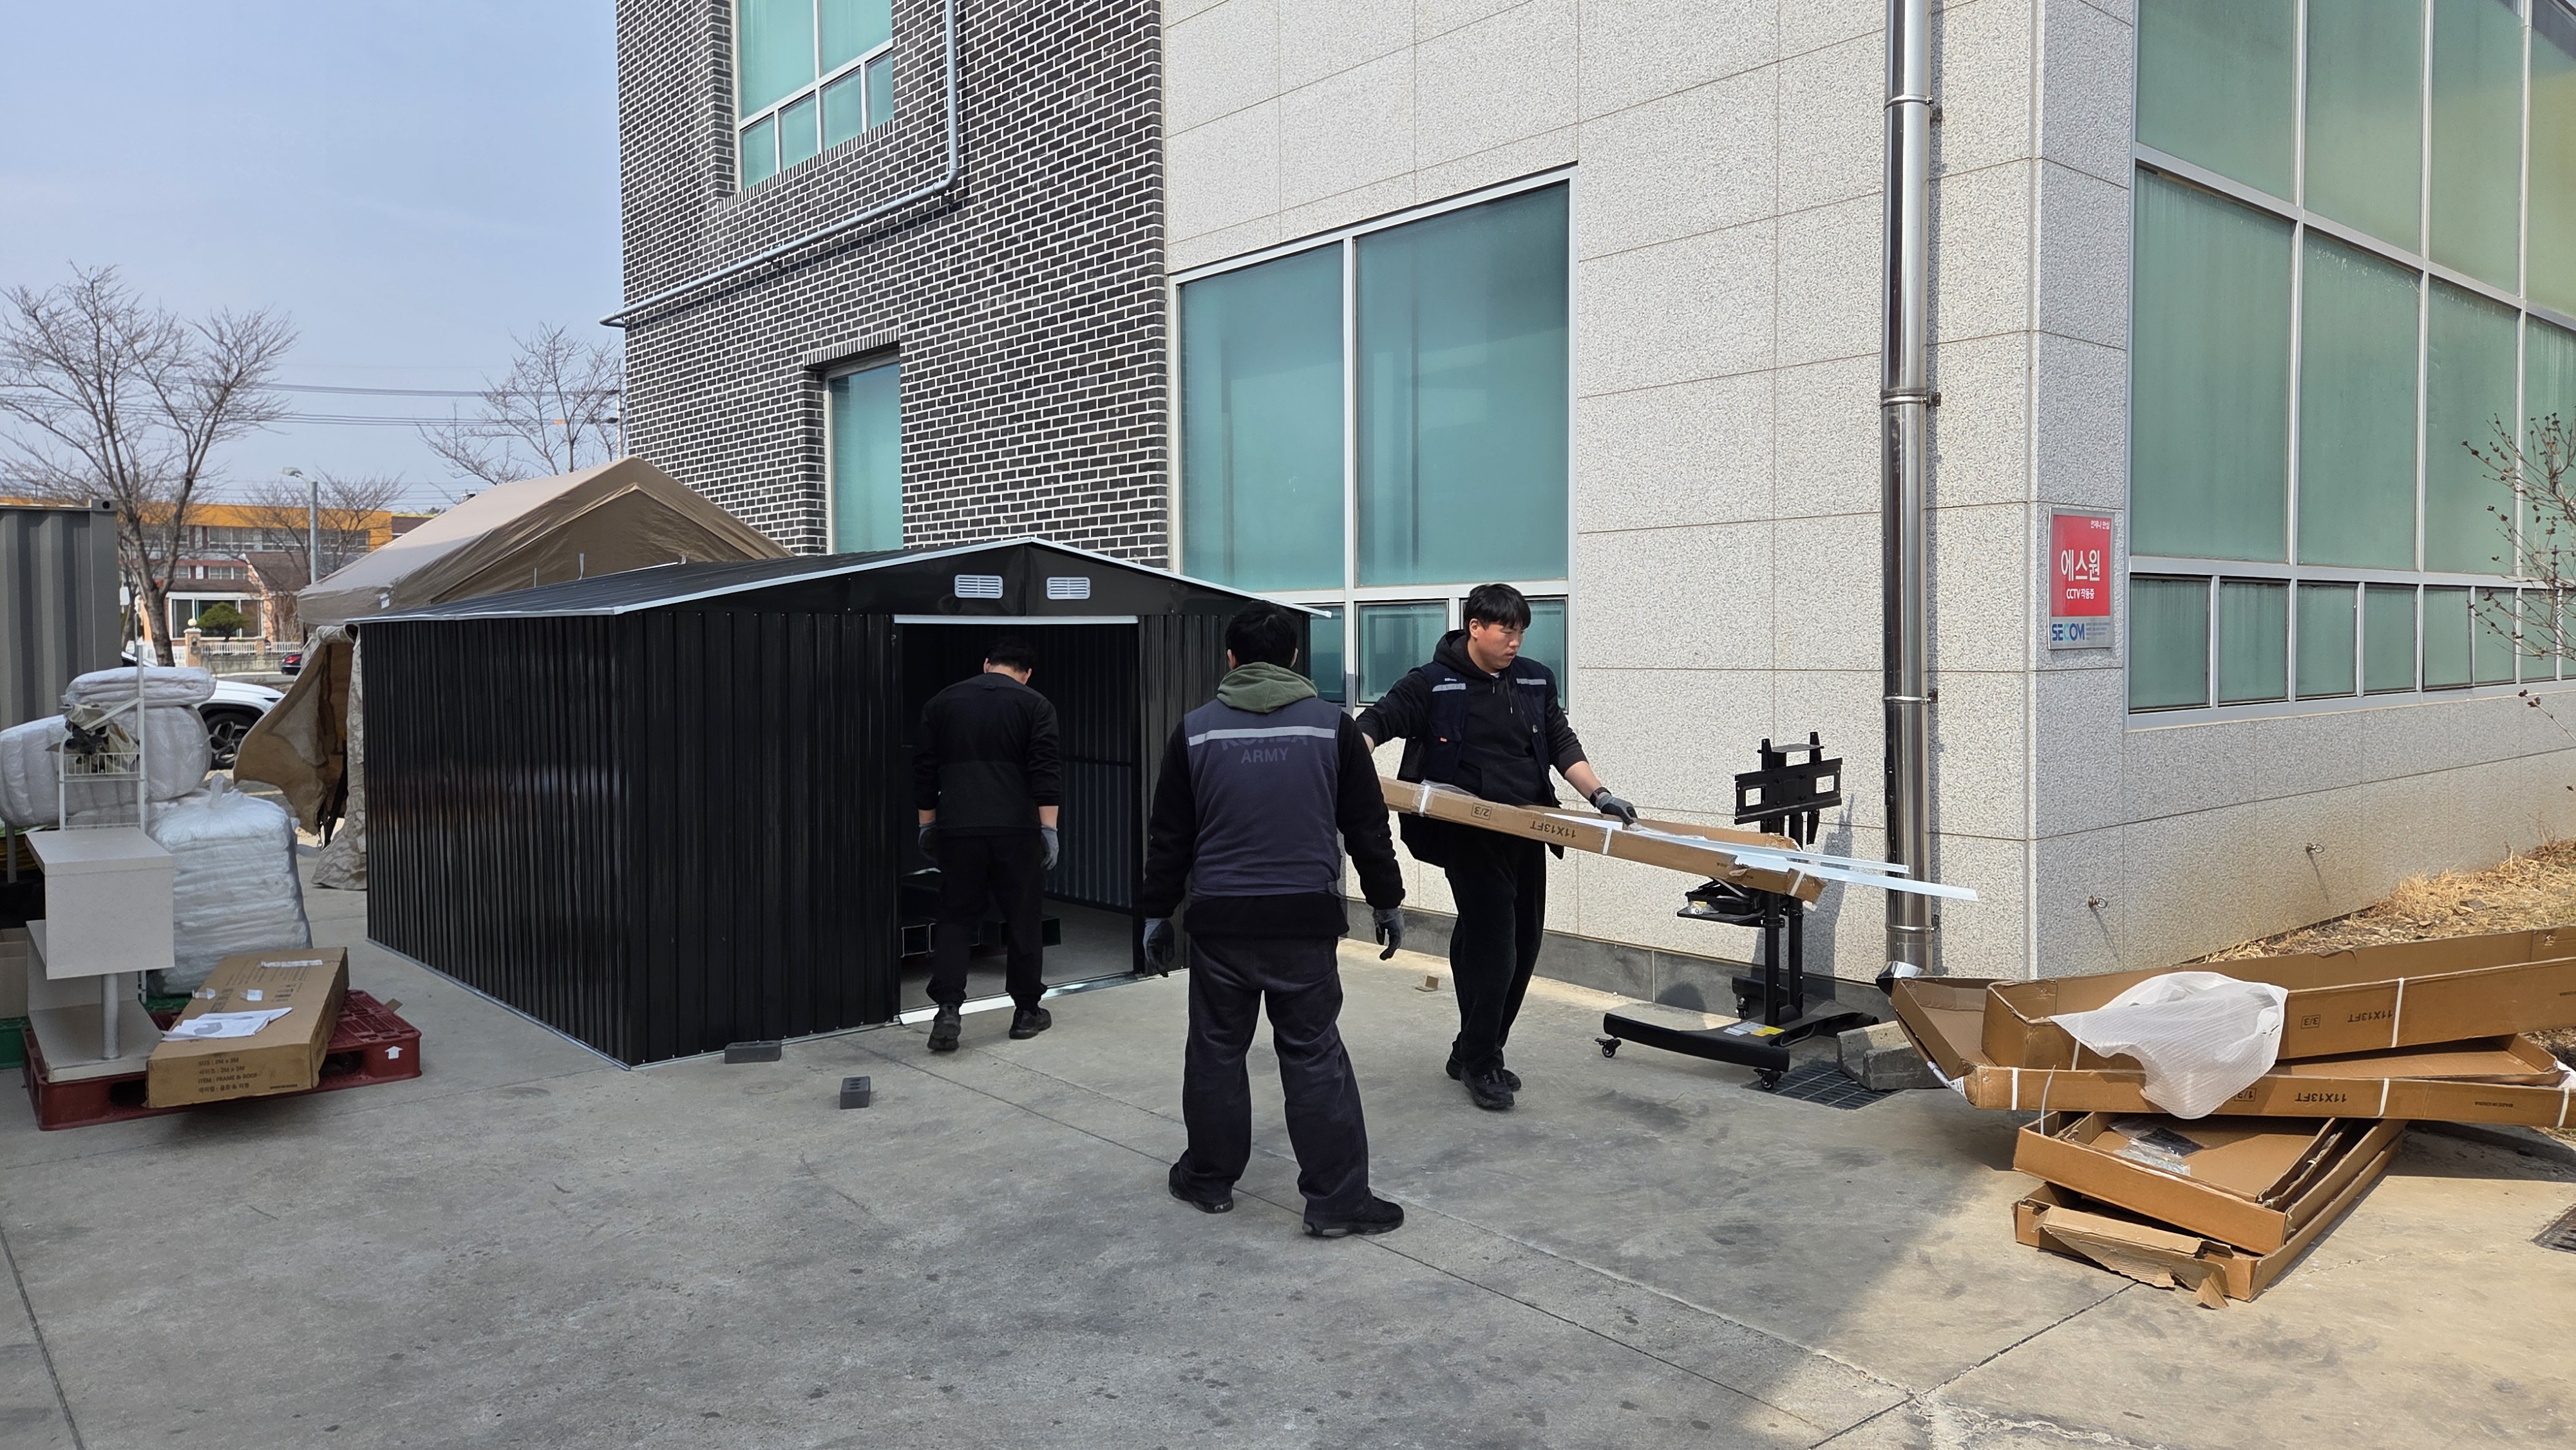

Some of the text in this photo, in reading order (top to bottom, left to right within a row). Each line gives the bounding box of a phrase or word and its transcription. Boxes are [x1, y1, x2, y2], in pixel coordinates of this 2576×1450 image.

[2061, 549, 2100, 581] 에스원
[2066, 588, 2094, 599] CCTV 작동중
[2052, 623, 2085, 641] SECOM
[1240, 748, 1289, 764] ARMY
[1474, 806, 1490, 817] 2/3
[1530, 821, 1577, 838] 11X13FT
[2347, 1010, 2392, 1022] 11X13FT
[2295, 1093, 2347, 1102] 11X13FT
